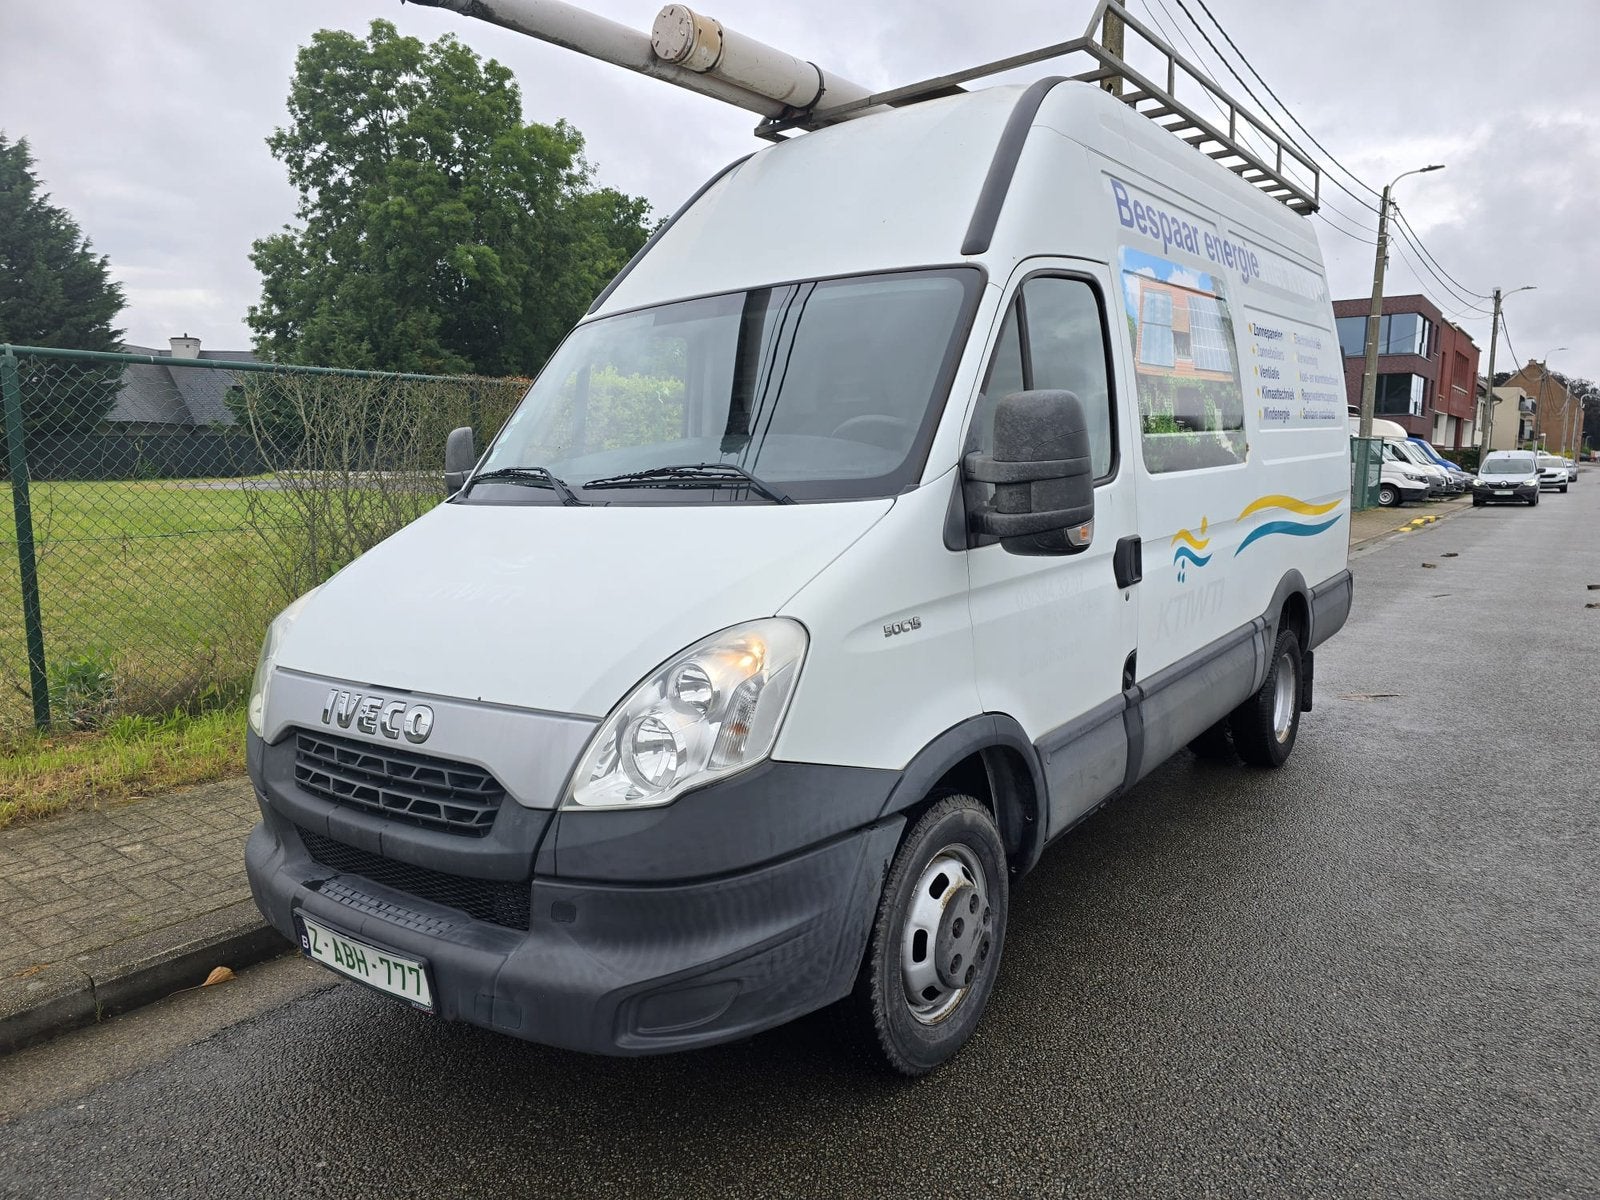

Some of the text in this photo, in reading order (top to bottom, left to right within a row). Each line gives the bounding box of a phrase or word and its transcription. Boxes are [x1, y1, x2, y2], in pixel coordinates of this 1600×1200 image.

[1110, 178, 1200, 255] Bespaar
[1204, 231, 1260, 285] energie
[1262, 385, 1295, 401] Klimaattechniek
[1263, 406, 1290, 423] Windenergie
[883, 616, 922, 638] 50C15
[321, 688, 435, 744] IVECO
[301, 934, 309, 949] B
